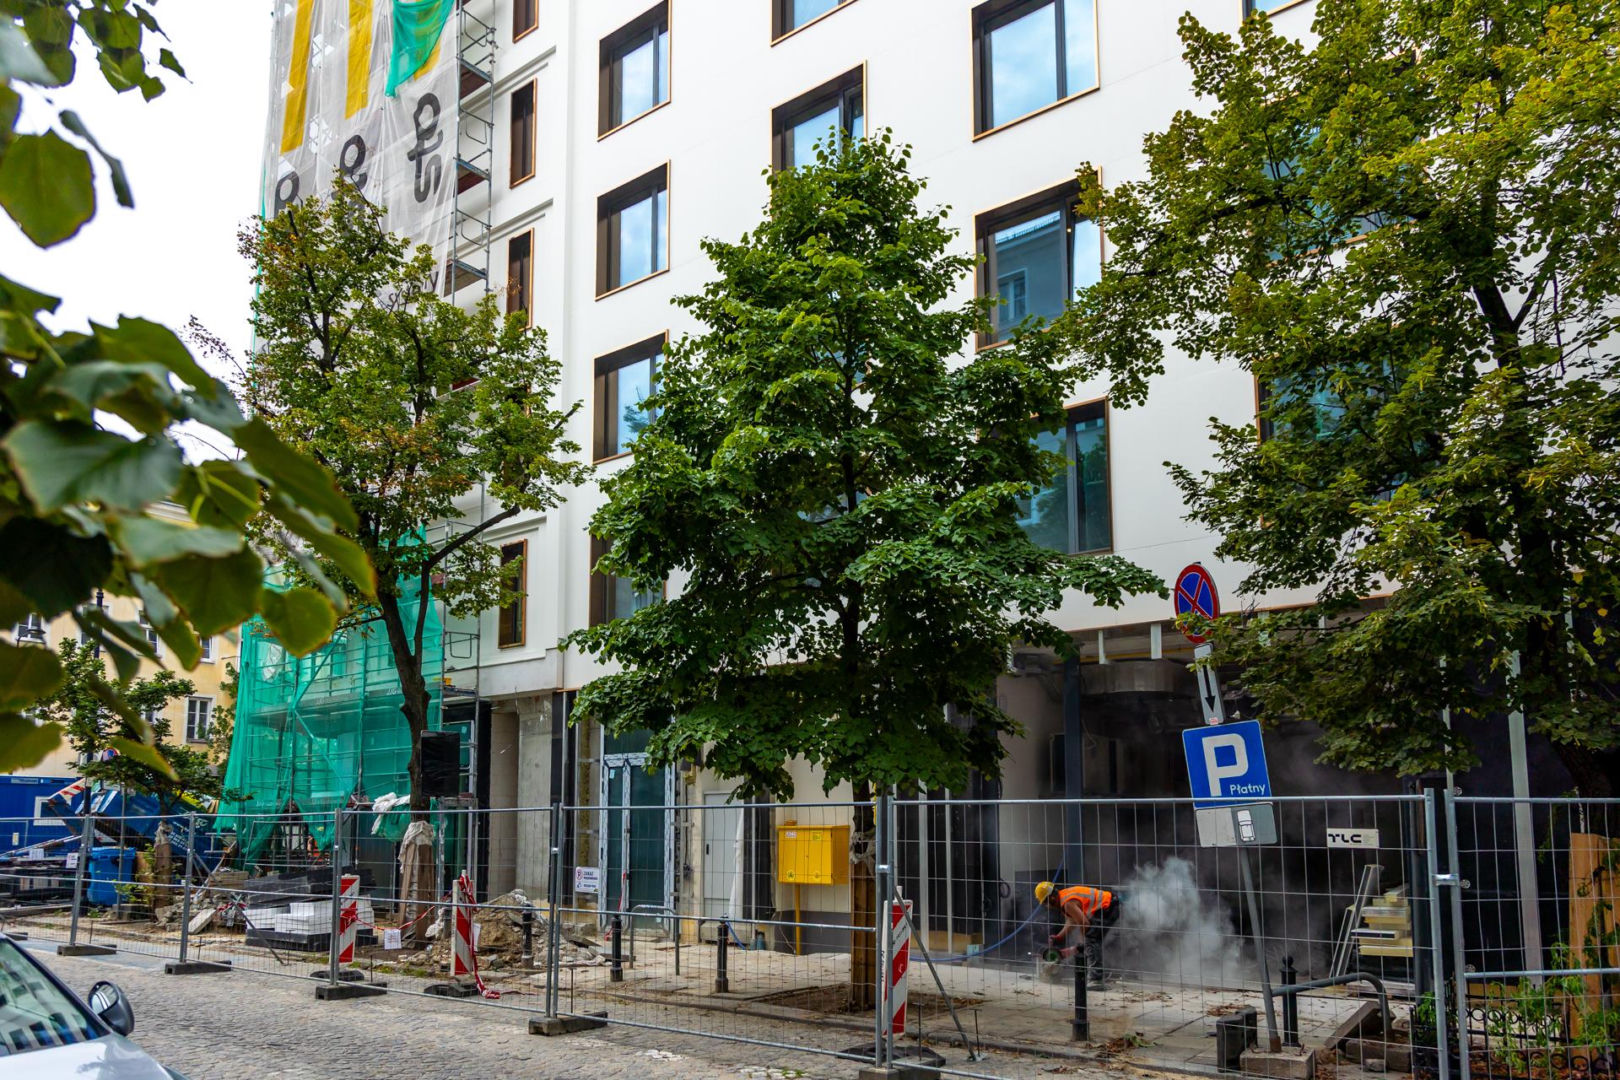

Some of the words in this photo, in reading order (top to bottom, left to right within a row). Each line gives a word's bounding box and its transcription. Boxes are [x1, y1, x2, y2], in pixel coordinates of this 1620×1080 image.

[407, 92, 443, 203] sto
[1202, 733, 1249, 797] P
[1229, 783, 1266, 796] Płatny
[1328, 833, 1362, 844] TLC
